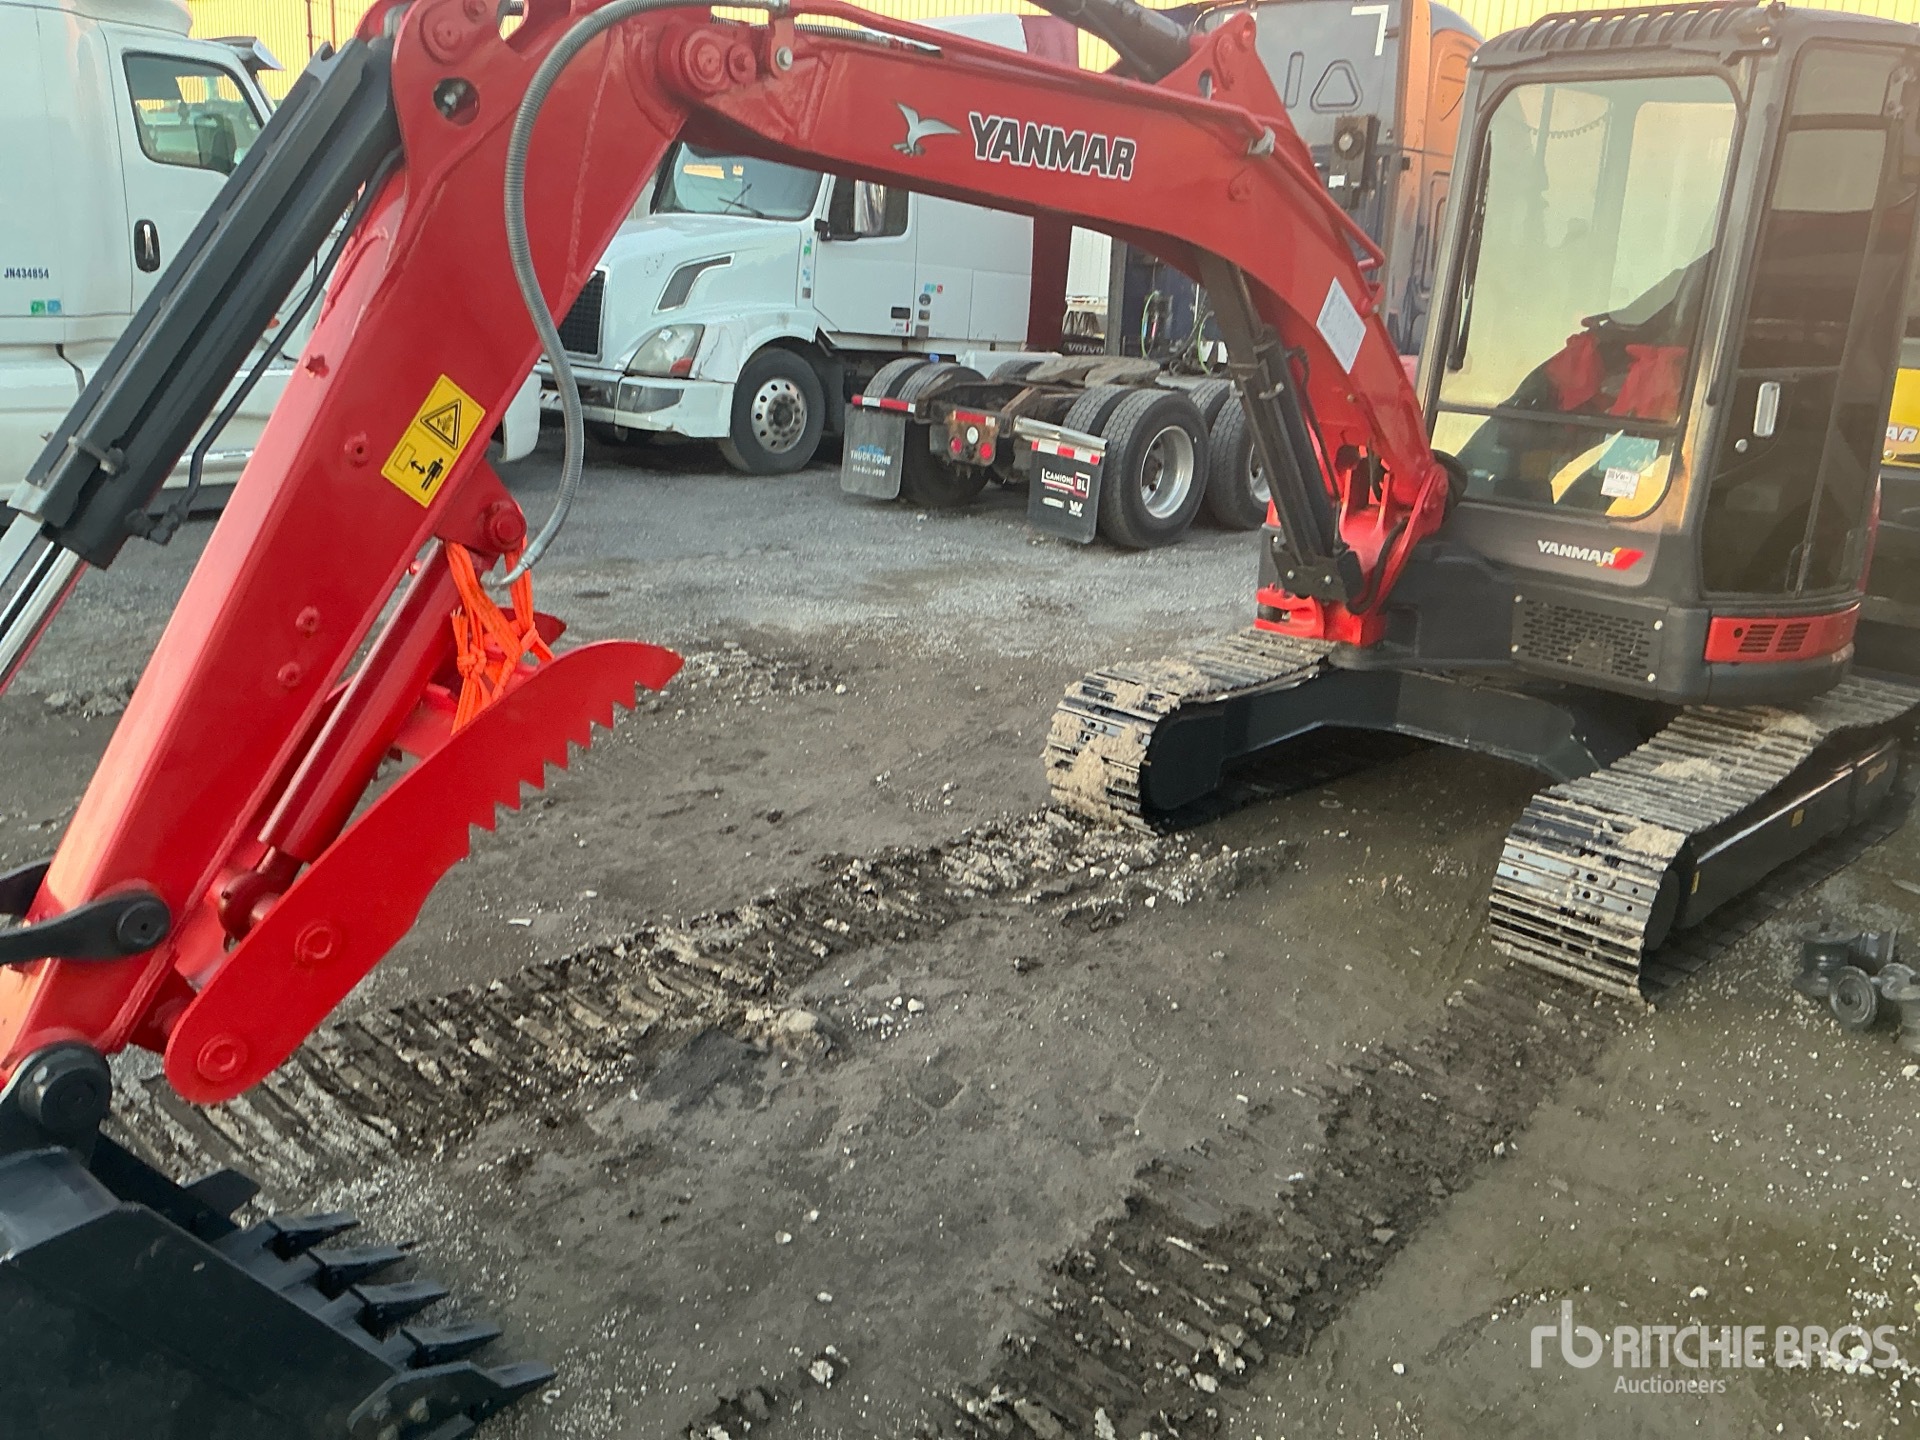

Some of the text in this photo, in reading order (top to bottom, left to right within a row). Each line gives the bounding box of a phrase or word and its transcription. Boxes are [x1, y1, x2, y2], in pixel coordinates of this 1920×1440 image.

[968, 111, 1136, 181] YANMAR
[1068, 343, 1104, 354] VOLVO
[1537, 540, 1616, 566] YANMAR
